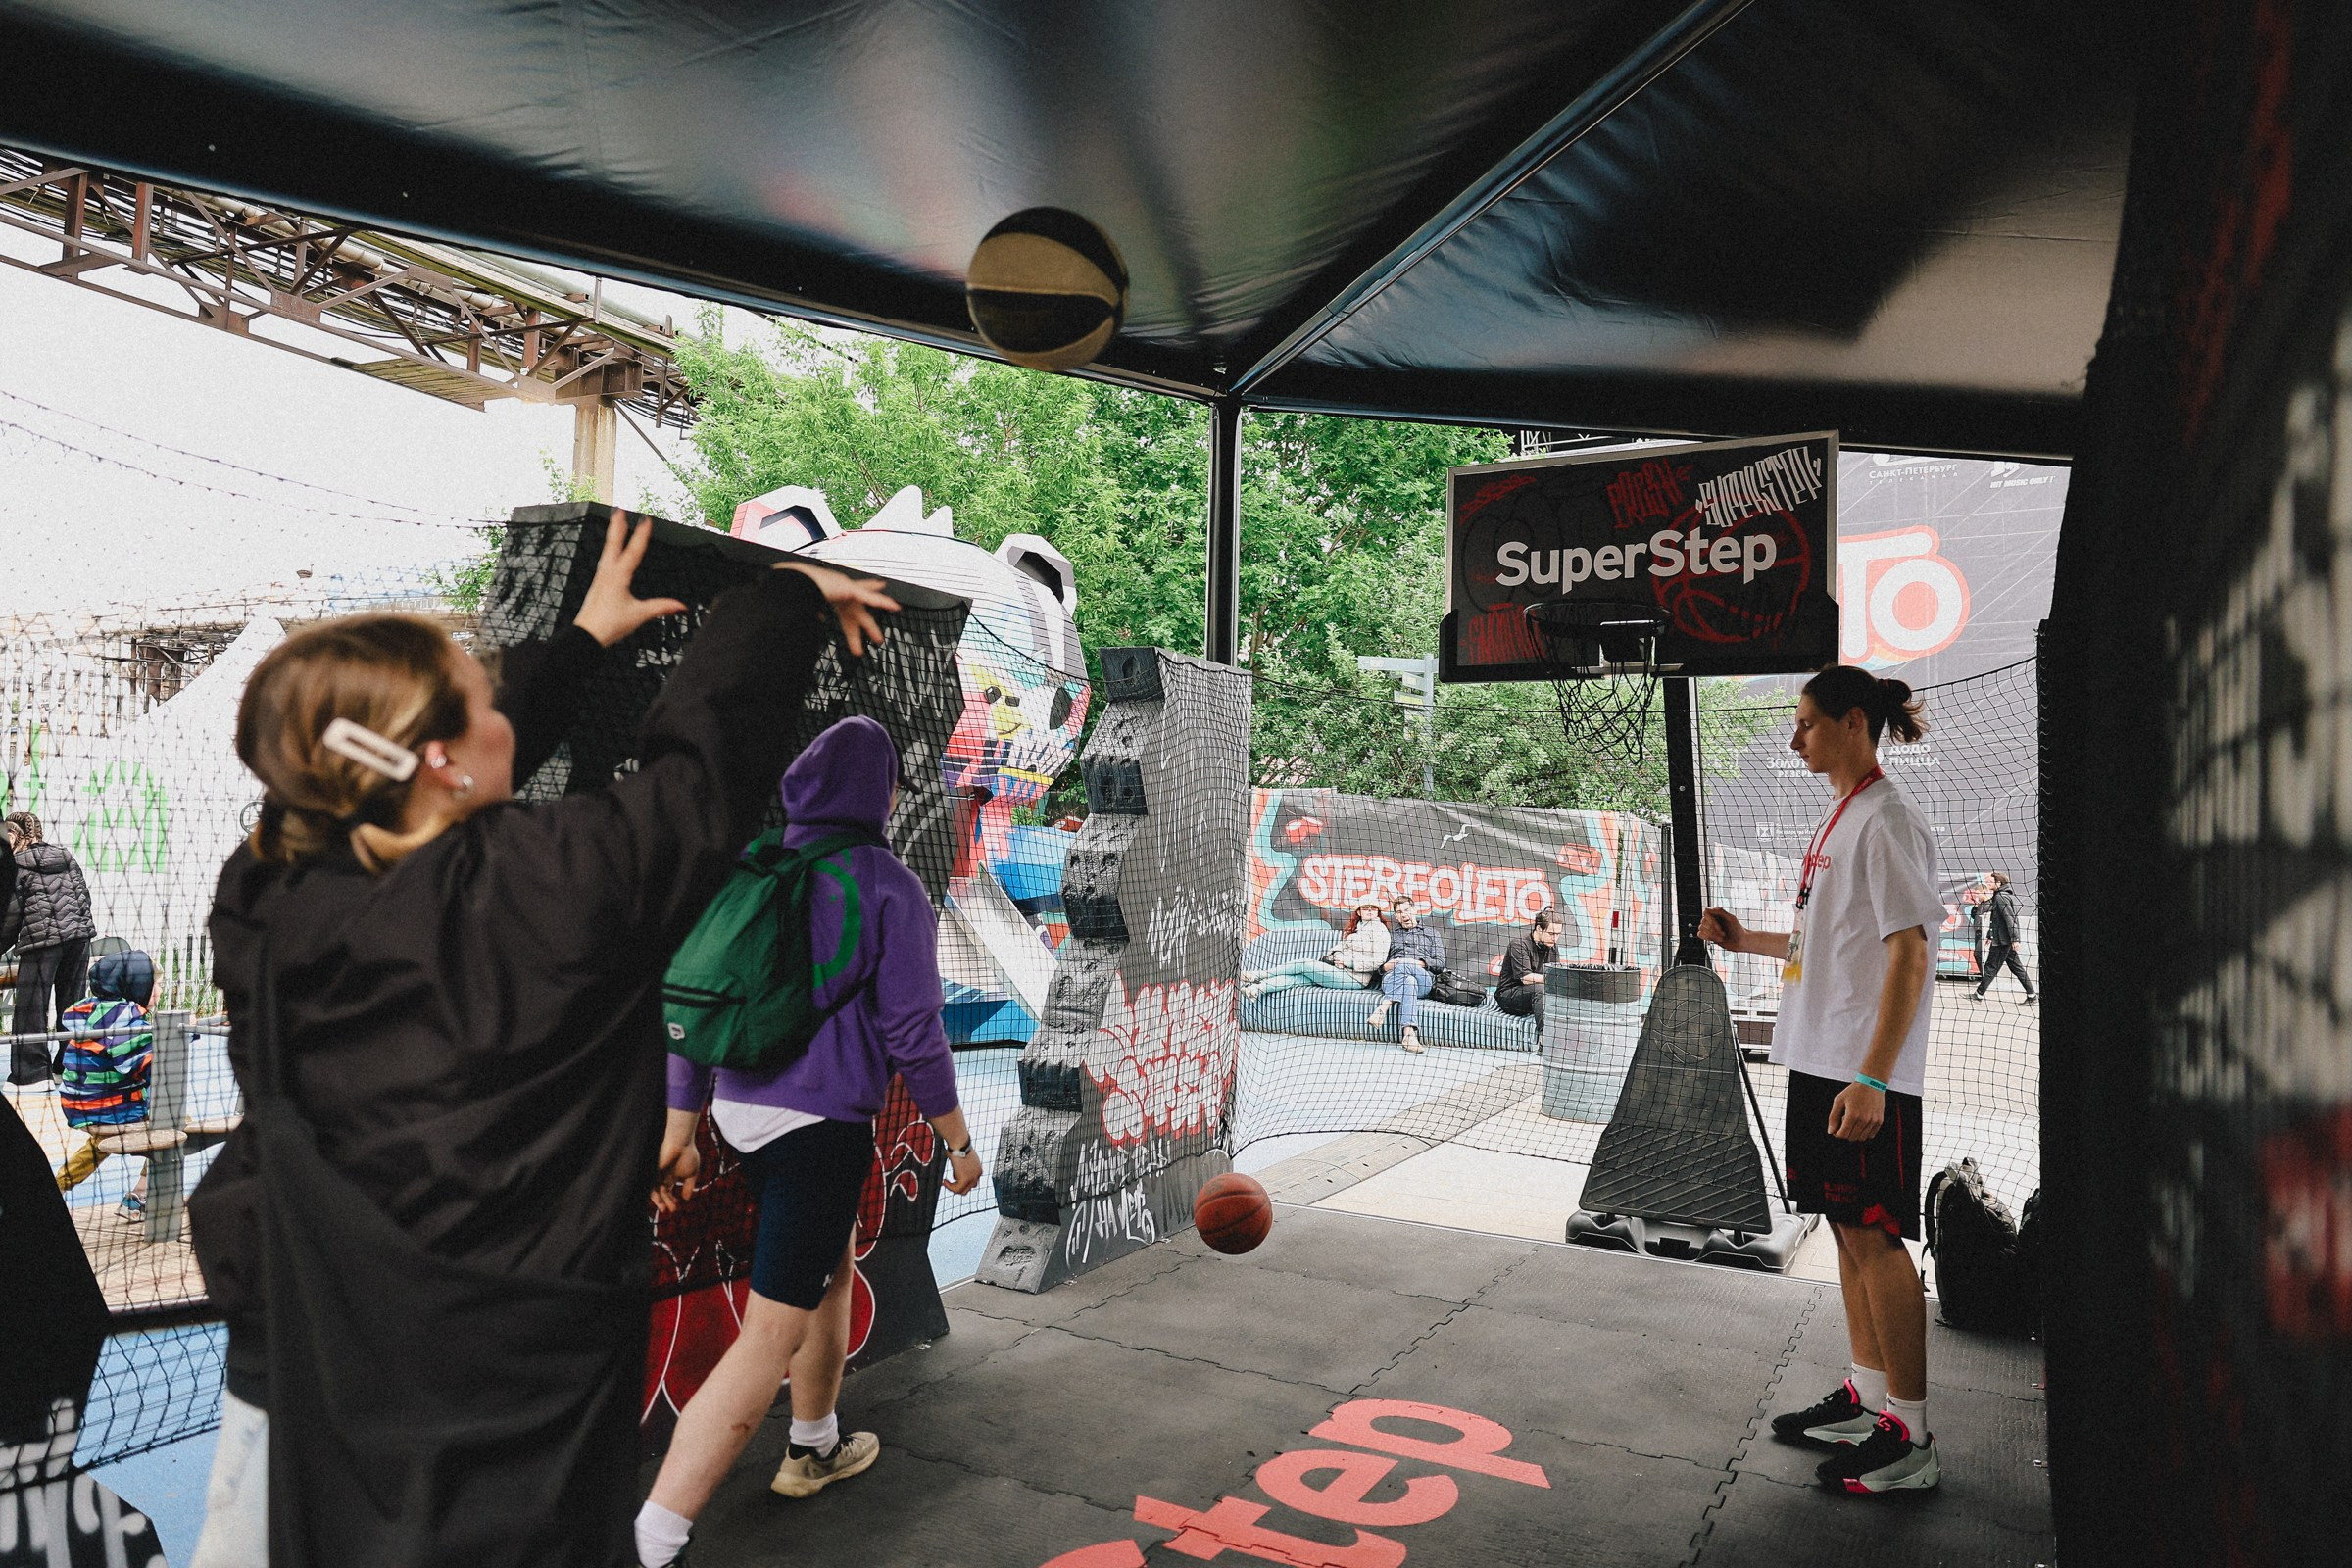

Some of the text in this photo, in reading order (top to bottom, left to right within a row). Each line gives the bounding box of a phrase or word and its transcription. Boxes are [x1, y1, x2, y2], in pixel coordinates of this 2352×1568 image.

[1868, 463, 1958, 479] САНКТ-ПЕТЕРБУРГ
[2004, 479, 2029, 488] MUSIC
[2029, 477, 2048, 486] ONLY
[1495, 528, 1777, 594] SuperStep
[1888, 744, 1931, 755] ДОДО
[1888, 757, 1941, 767] ПИЦЦА
[1301, 855, 1553, 922] STEREOLETO
